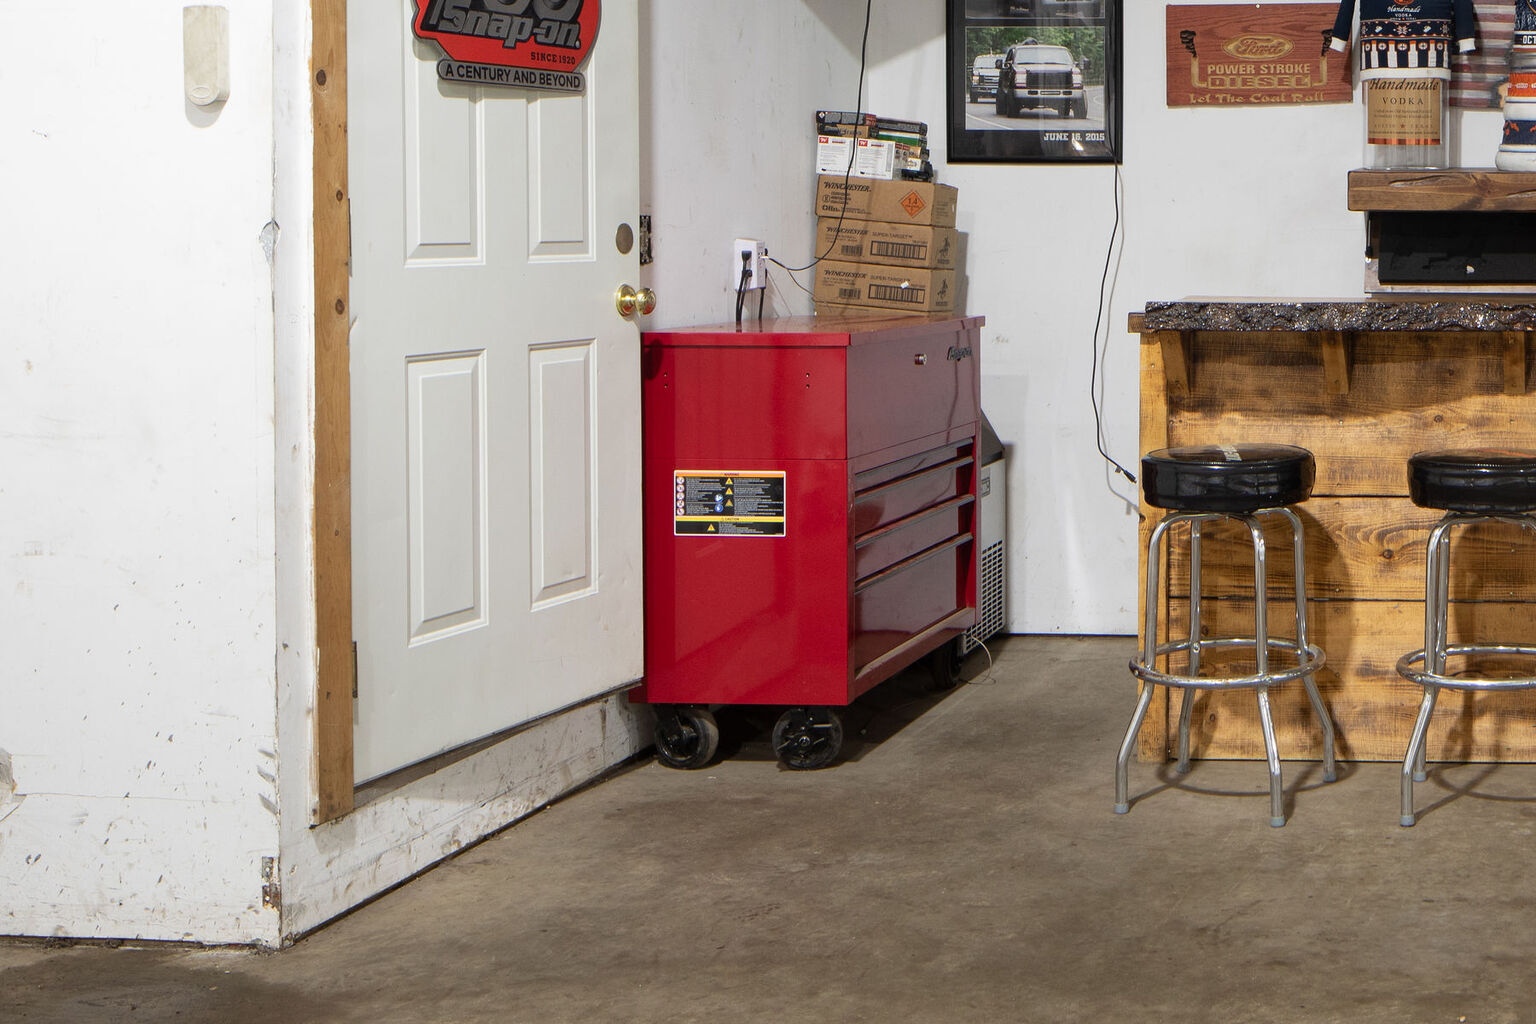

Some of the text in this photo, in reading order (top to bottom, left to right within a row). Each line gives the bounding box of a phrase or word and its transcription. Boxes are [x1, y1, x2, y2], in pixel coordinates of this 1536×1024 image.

[530, 51, 576, 66] SINCE 1920
[1207, 63, 1311, 75] POWER STROKE
[445, 64, 581, 89] A CENTURY AND BEYOND
[1207, 75, 1312, 89] DIESEL
[1369, 78, 1440, 91] Handmade
[1189, 92, 1325, 104] Let The Coal Roll
[1382, 96, 1424, 105] VODKA
[1043, 132, 1069, 142] JUNE
[1085, 132, 1105, 142] 2015
[823, 181, 872, 193] WINCHESTER
